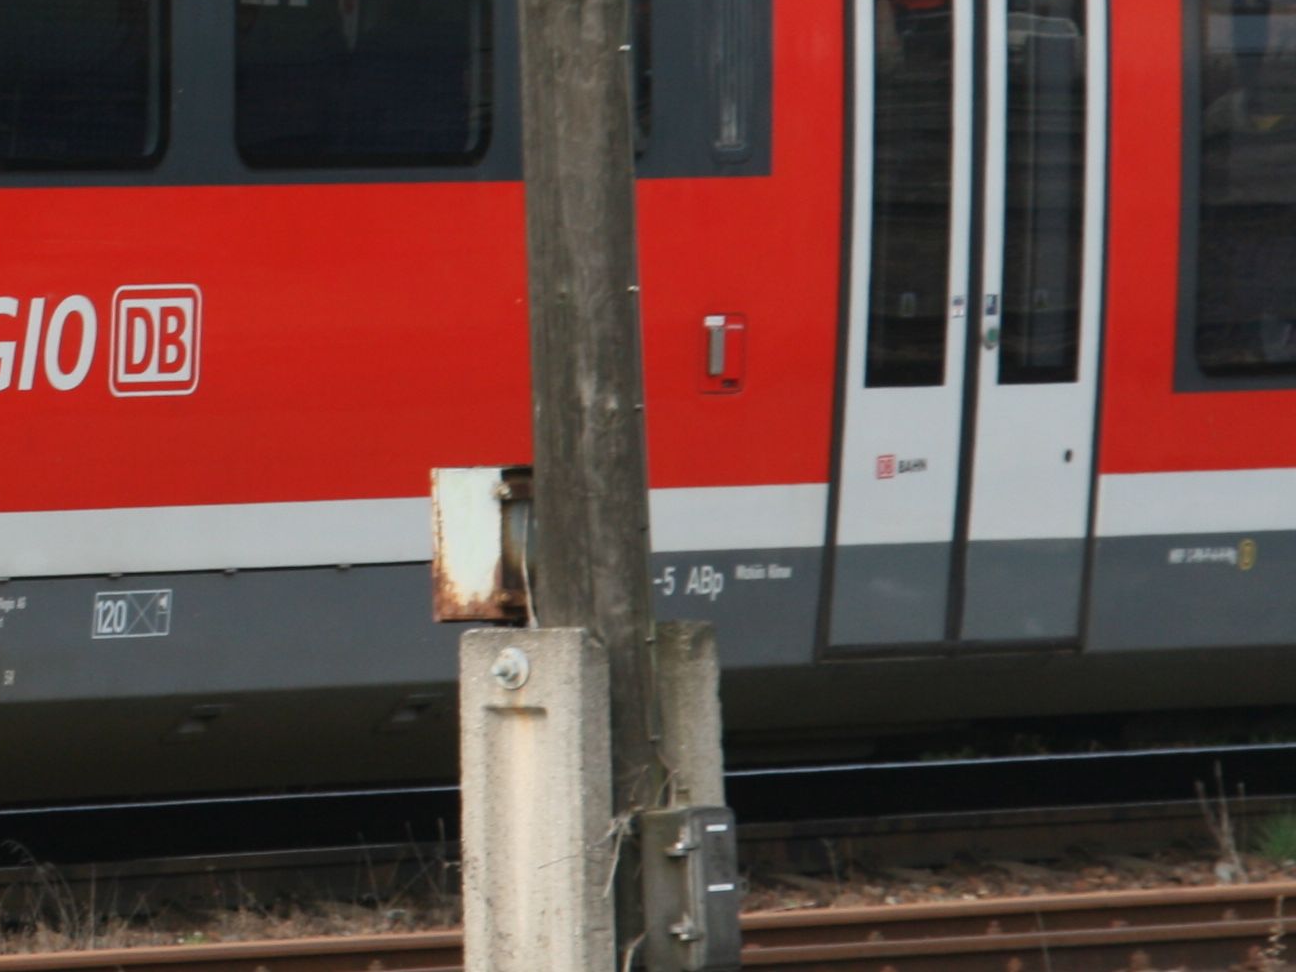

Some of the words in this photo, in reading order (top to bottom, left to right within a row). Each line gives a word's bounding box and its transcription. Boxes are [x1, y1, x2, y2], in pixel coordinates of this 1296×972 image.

[120, 301, 192, 380] DB
[684, 564, 725, 602] ABp
[95, 599, 127, 634] 120
